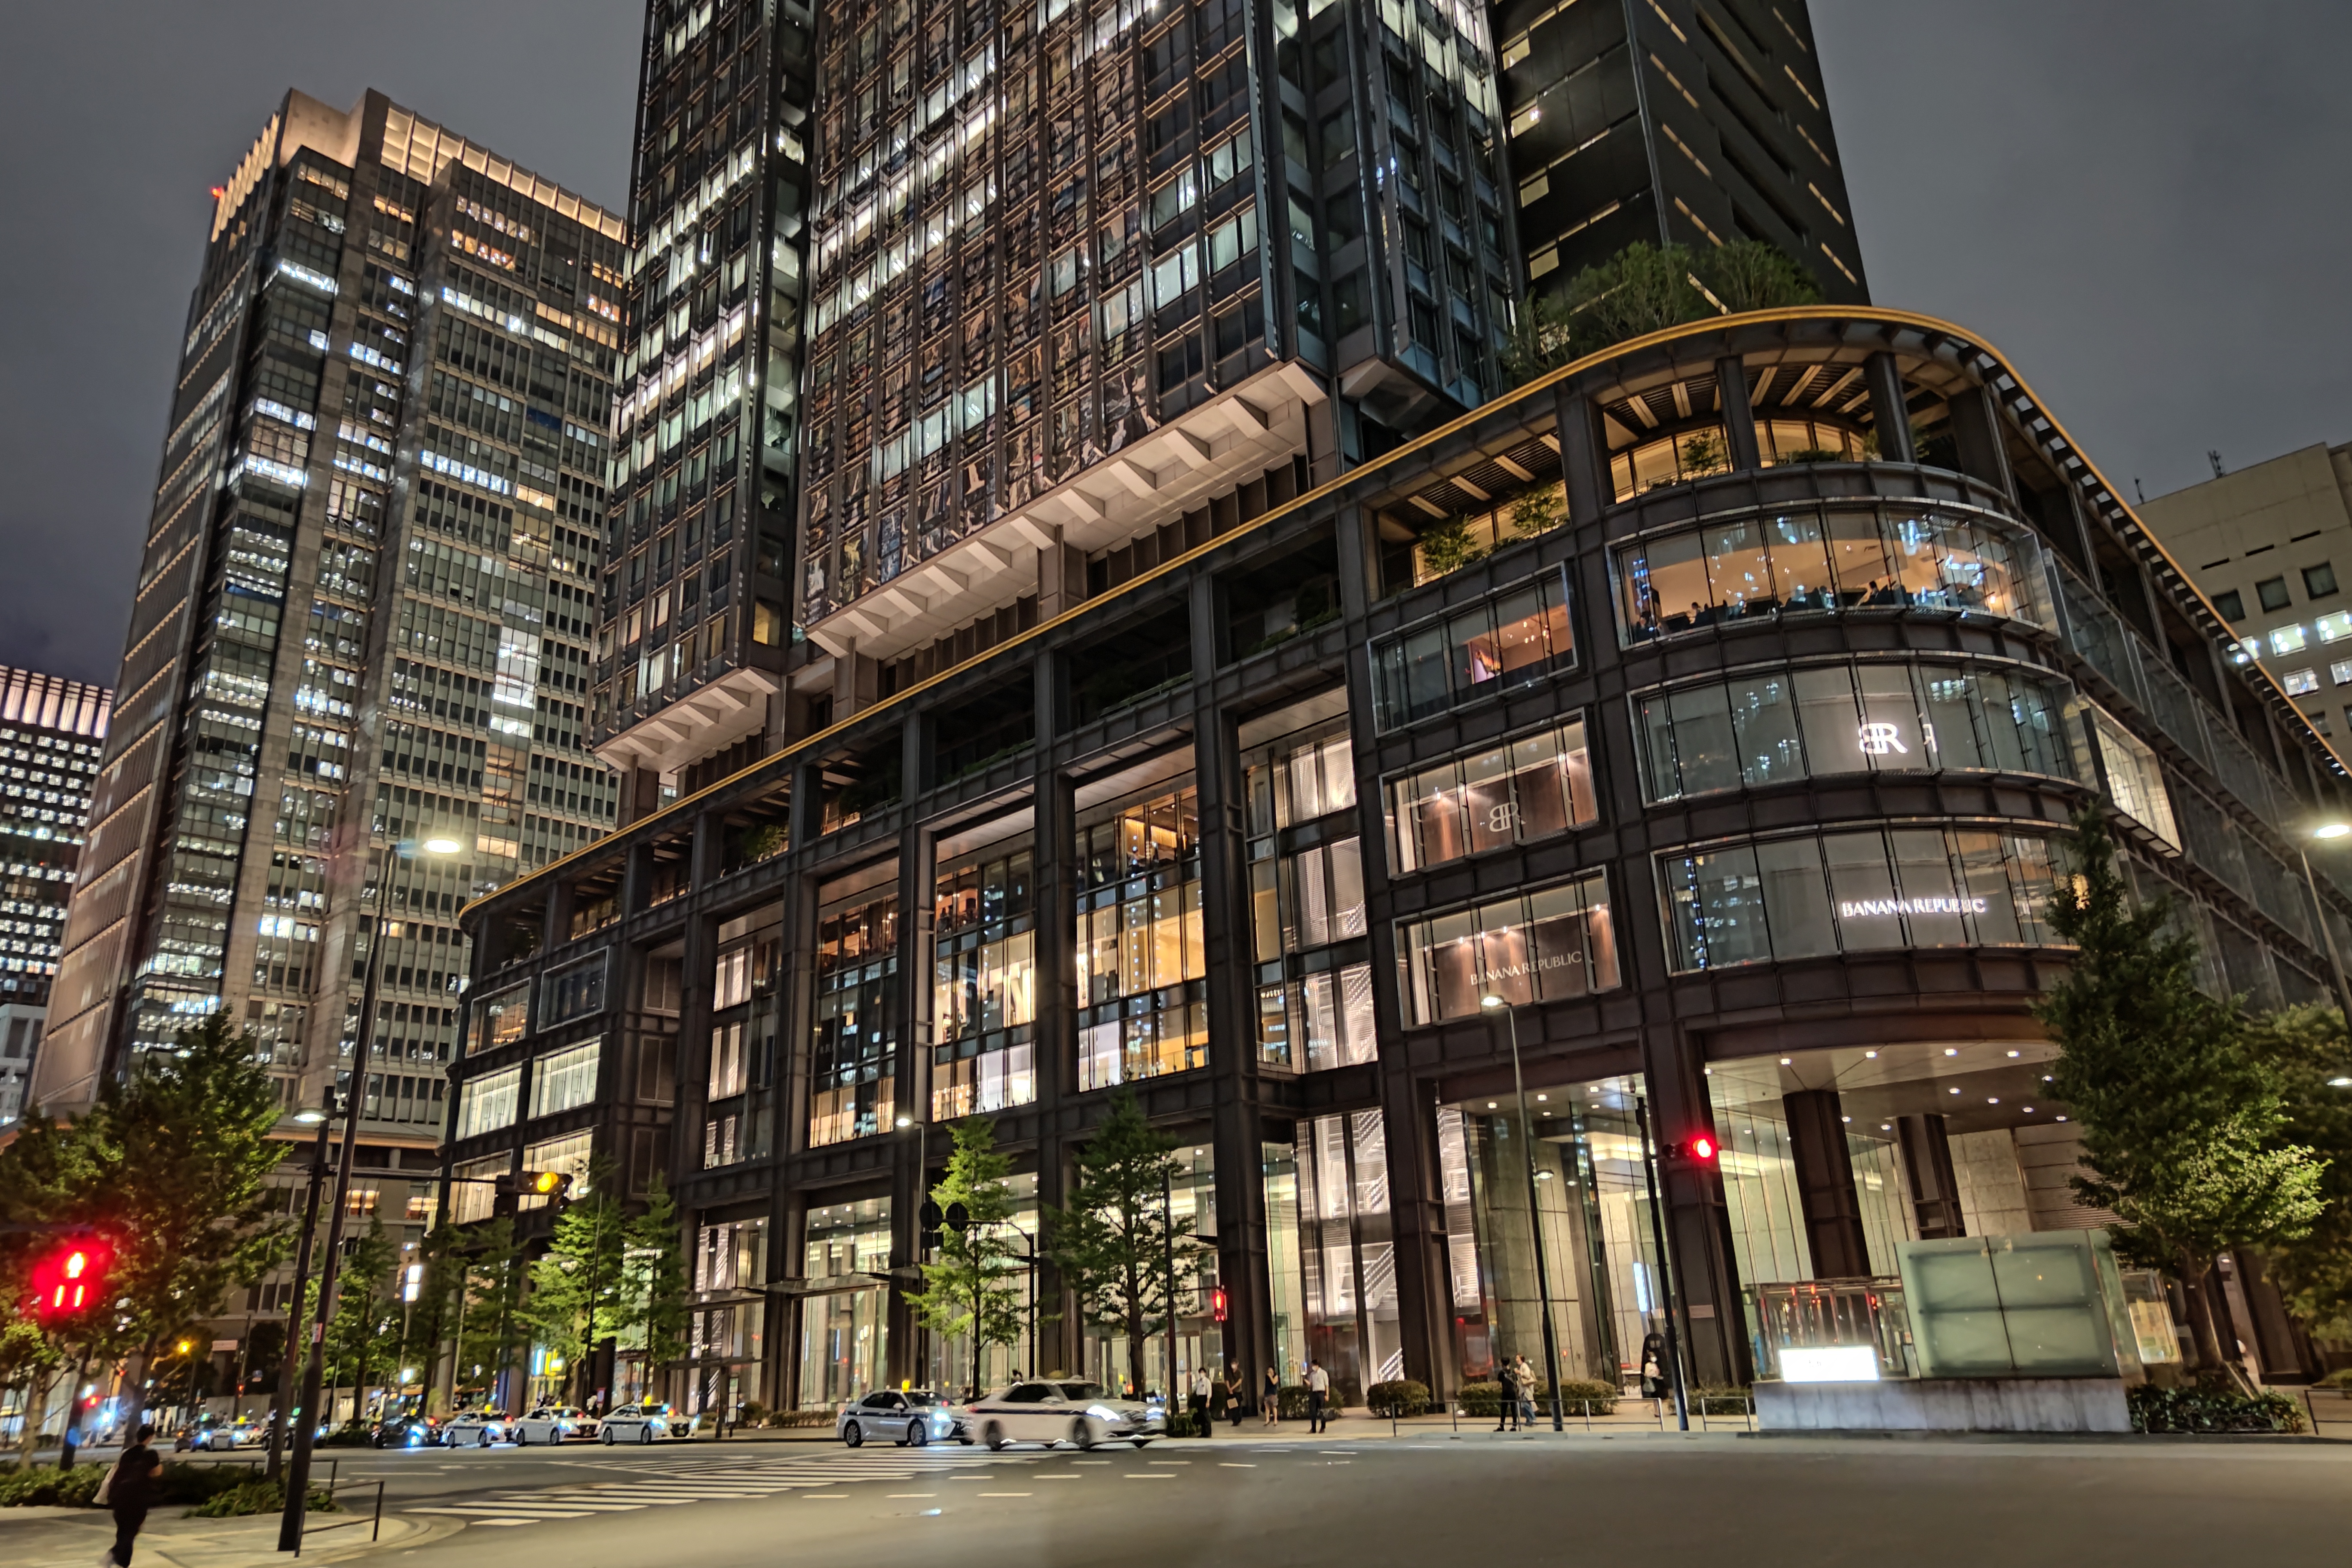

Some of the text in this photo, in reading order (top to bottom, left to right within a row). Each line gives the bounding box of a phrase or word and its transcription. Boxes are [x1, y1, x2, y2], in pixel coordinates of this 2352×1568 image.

[1842, 898, 1985, 917] BANANA REPUBLIC
[1470, 951, 1582, 986] BANANA REPUBLIC
